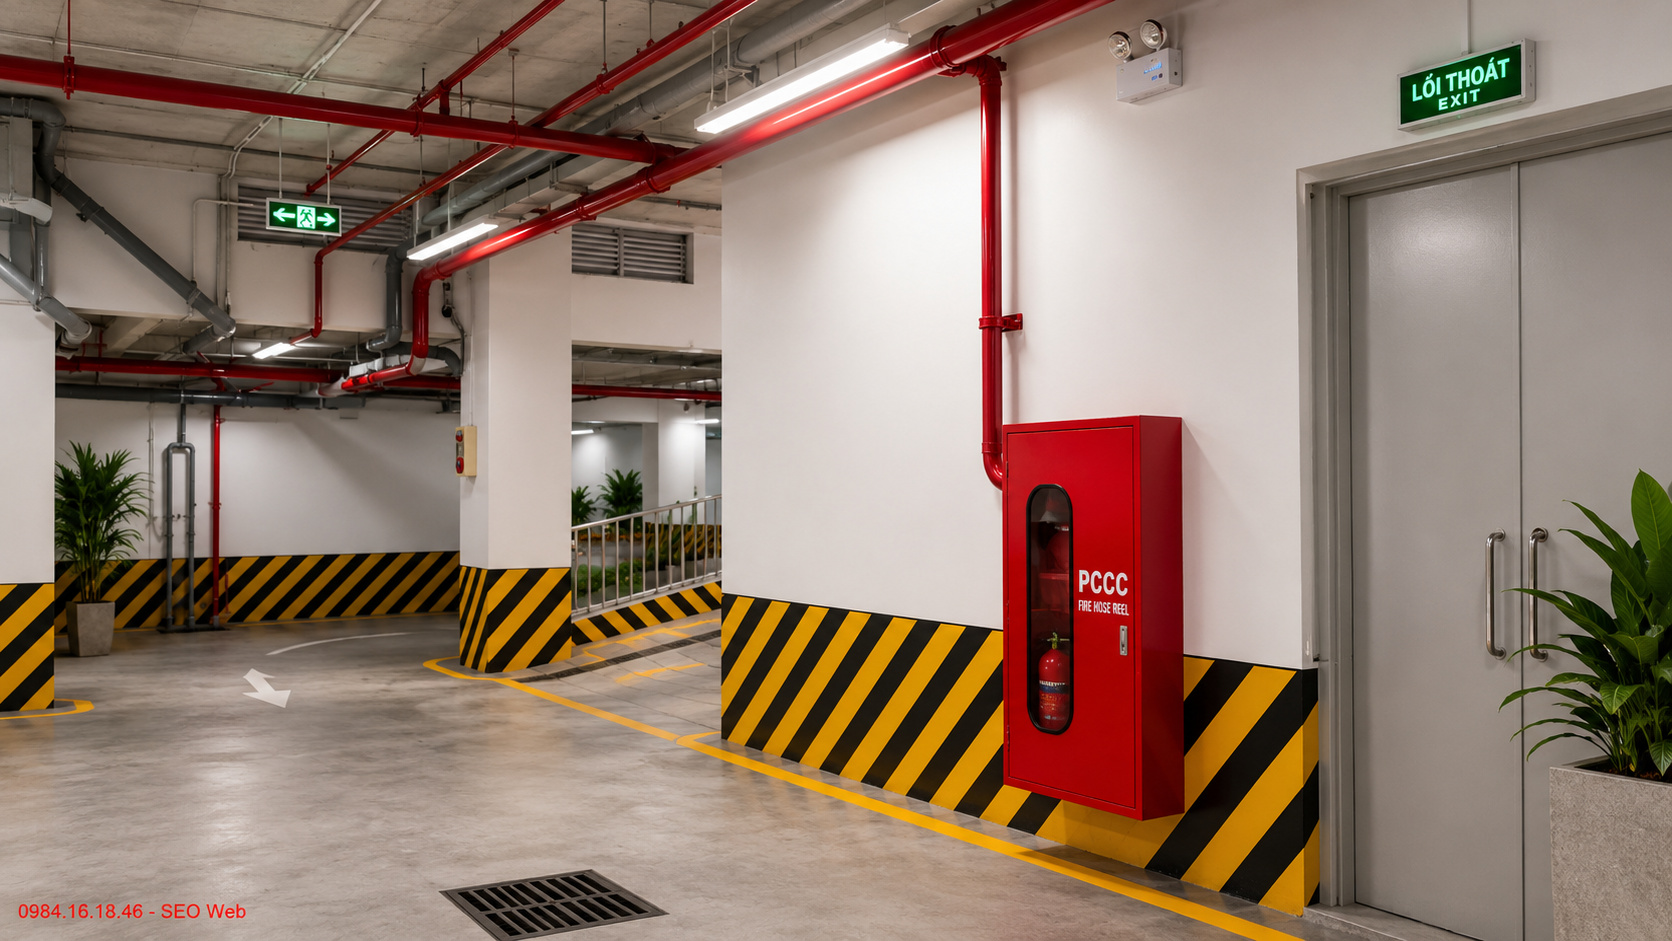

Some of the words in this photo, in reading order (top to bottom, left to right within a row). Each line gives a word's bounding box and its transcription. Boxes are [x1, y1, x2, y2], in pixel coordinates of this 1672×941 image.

[1445, 57, 1510, 92] THOÁT
[1438, 88, 1480, 111] EXIT
[1079, 569, 1128, 597] PCCC
[1093, 600, 1111, 614] HOSE
[1112, 602, 1129, 616] REEL
